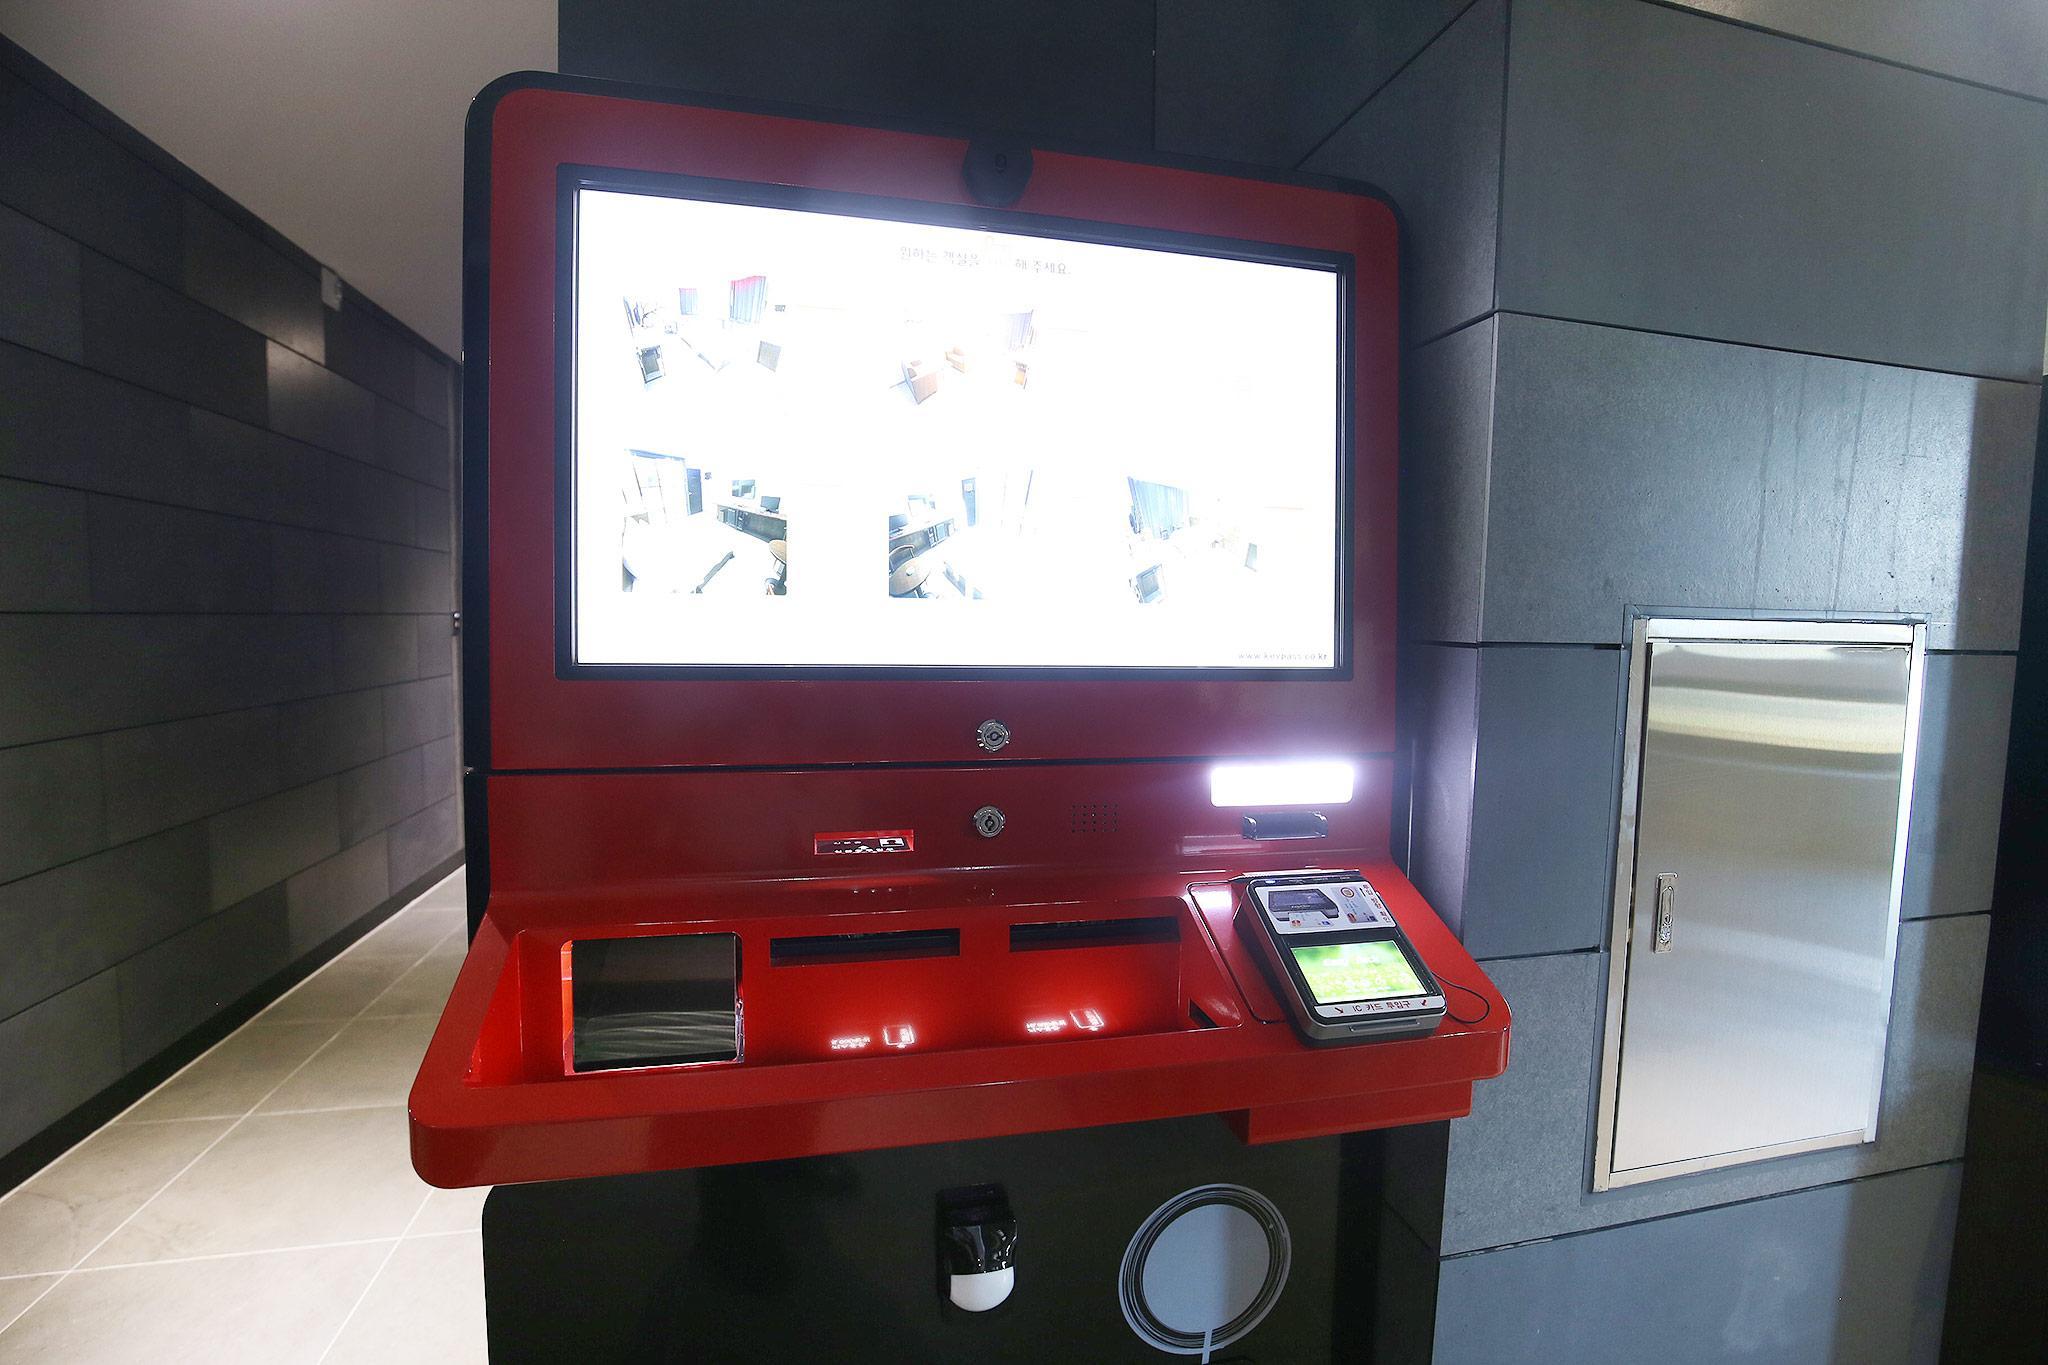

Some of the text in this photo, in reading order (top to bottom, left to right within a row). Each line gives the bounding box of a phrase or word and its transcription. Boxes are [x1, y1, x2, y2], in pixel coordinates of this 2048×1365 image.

[1352, 1000, 1411, 1012] IC 카드 투입구
